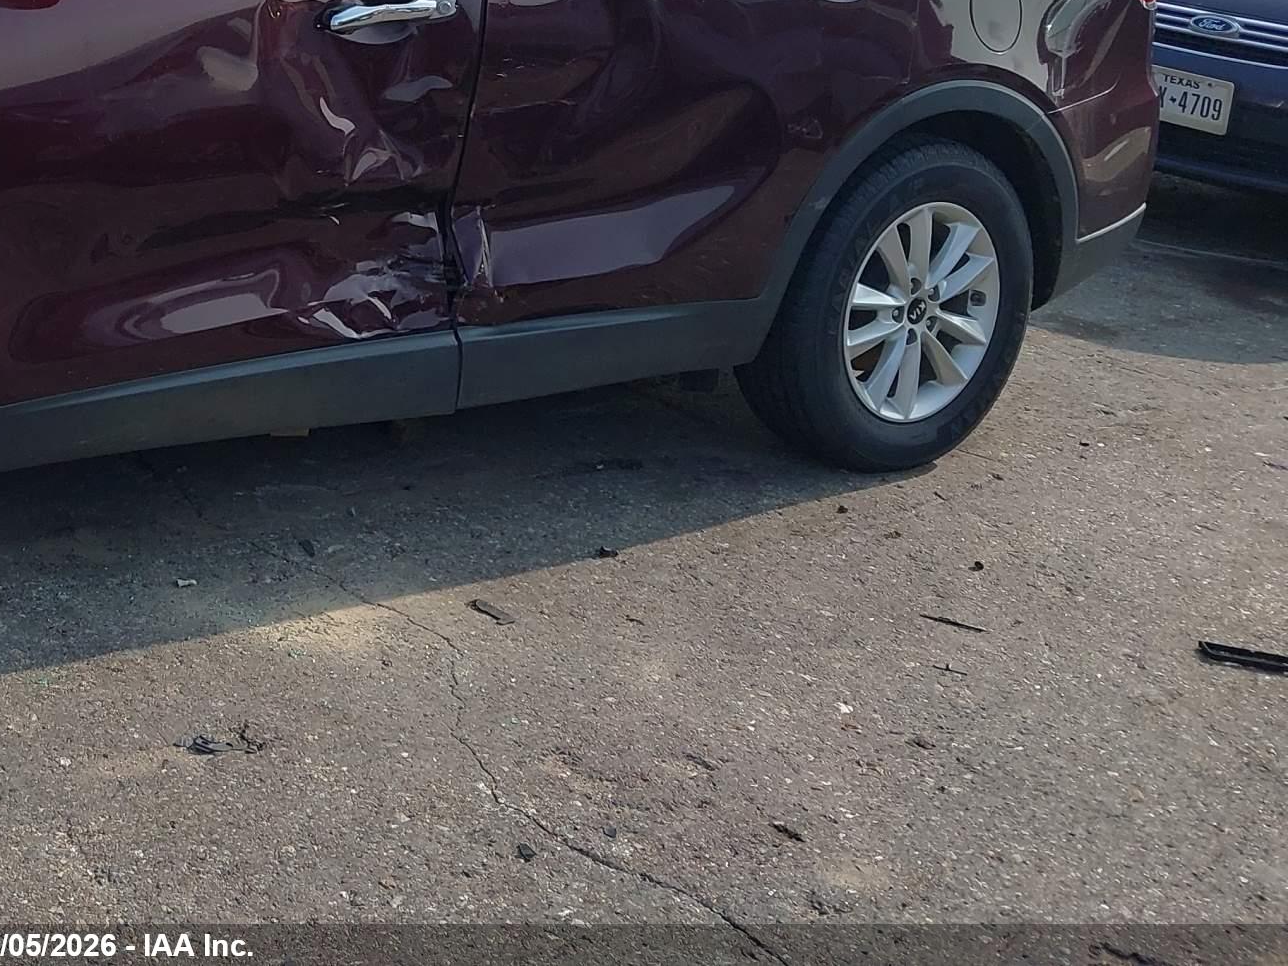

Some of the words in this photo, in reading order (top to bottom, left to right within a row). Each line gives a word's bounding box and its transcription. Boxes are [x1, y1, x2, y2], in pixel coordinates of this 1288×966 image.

[1198, 18, 1225, 31] Ford
[1162, 74, 1201, 90] TEXAS
[909, 301, 927, 321] KIA
